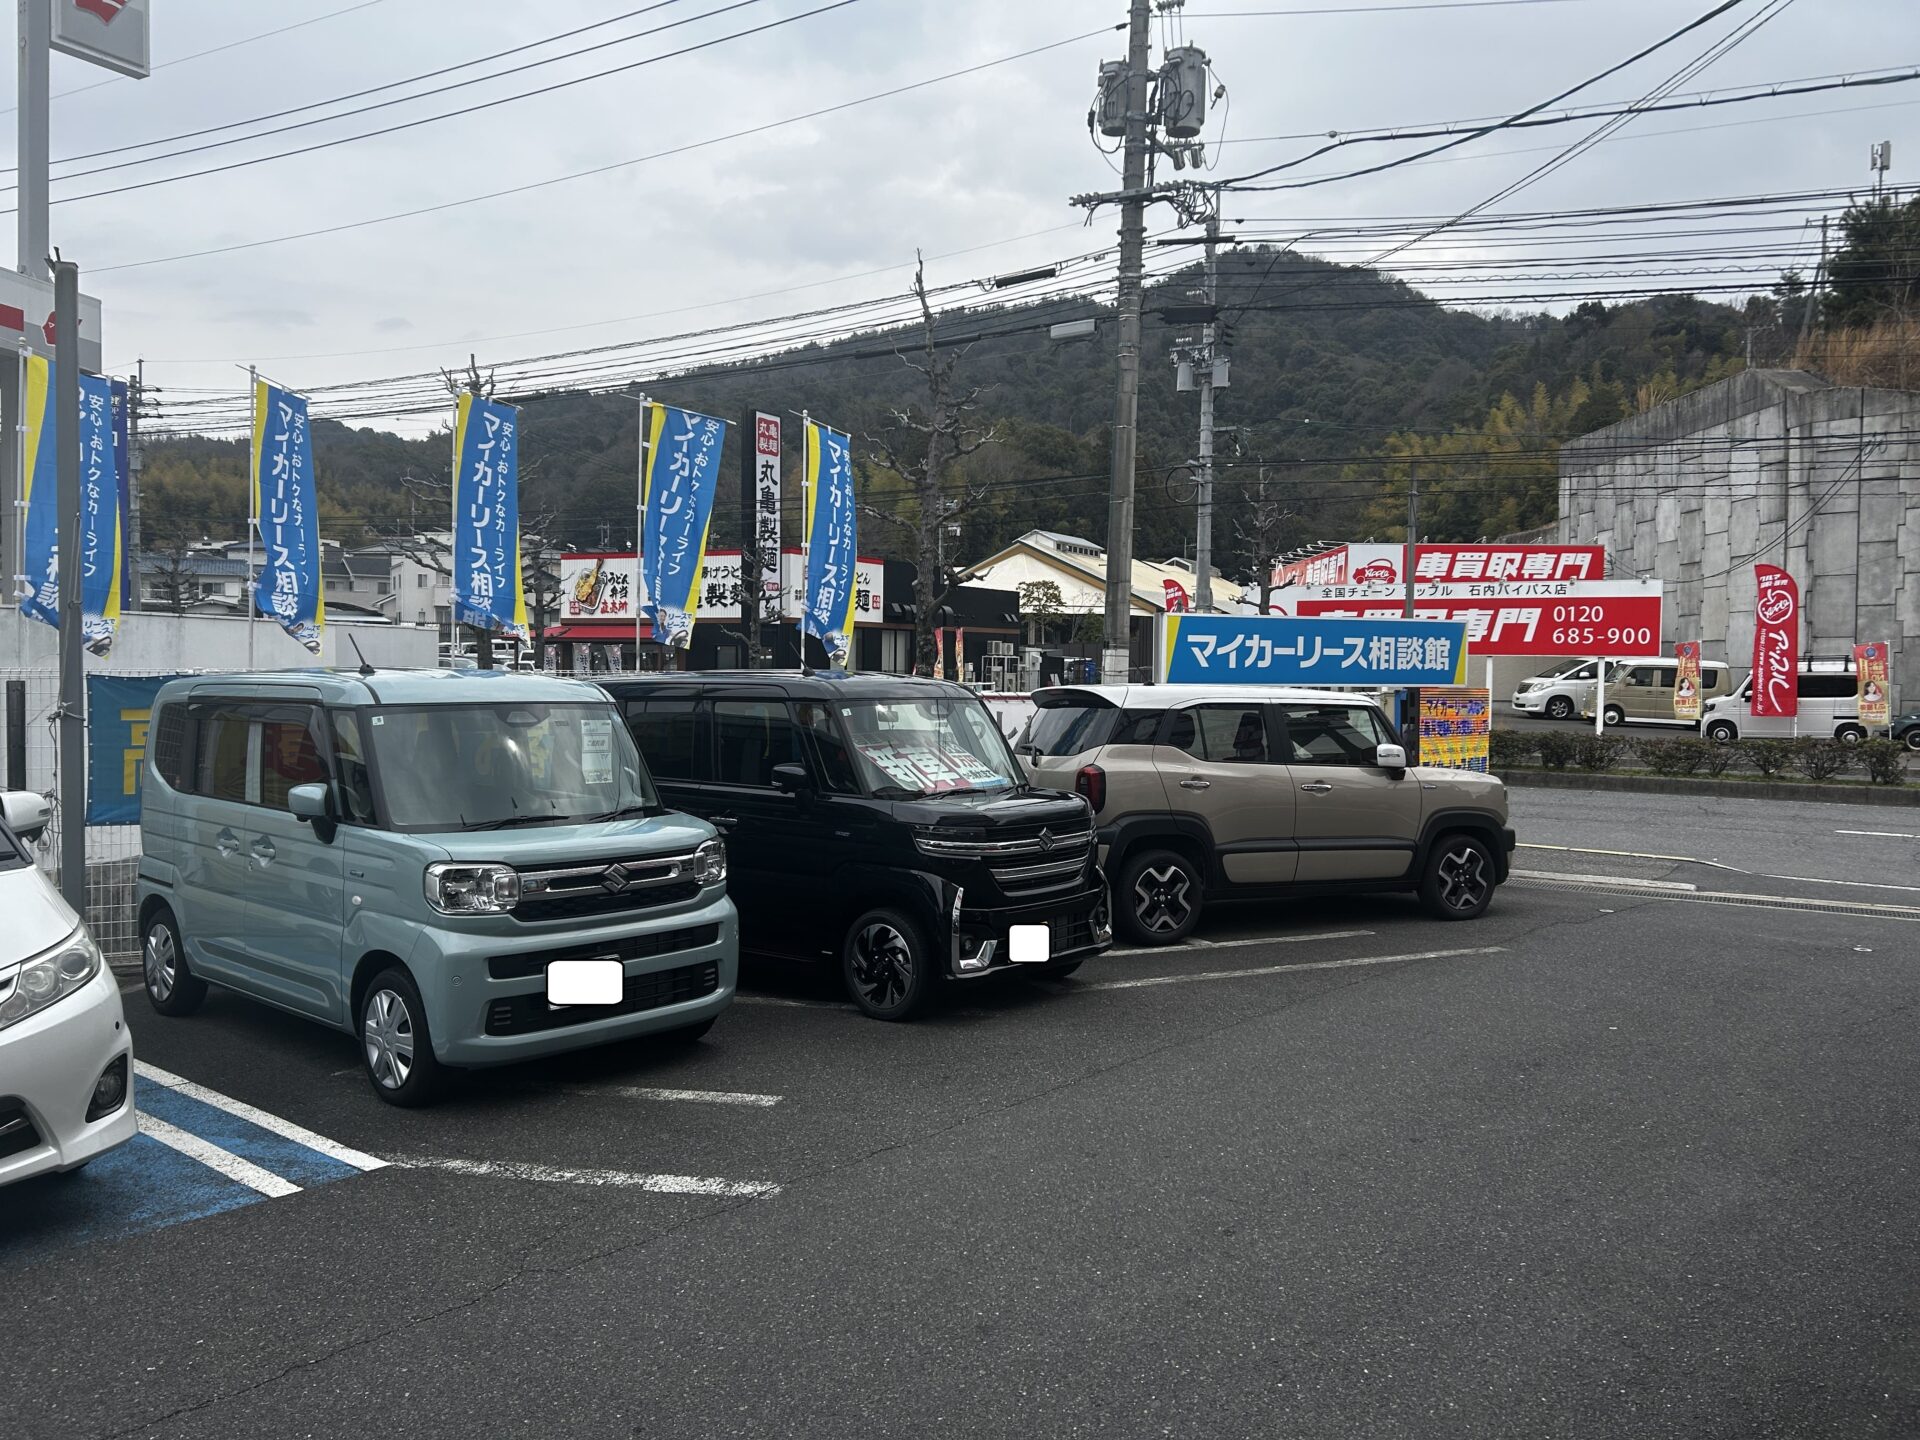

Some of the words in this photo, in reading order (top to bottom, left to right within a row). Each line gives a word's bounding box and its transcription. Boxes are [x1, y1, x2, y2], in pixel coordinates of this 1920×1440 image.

[83, 394, 104, 578] 安心・おトクなカーライフ
[271, 401, 299, 622] マイカーリース相談
[468, 411, 501, 614] マイカーリース相談
[493, 421, 514, 589] 安心・おトクなカーライフ
[758, 459, 779, 574] 丸亀製麺
[813, 439, 843, 626] マイカーリース相談
[607, 571, 630, 585] うどん
[610, 585, 629, 599] 弁当
[1321, 587, 1396, 599] 全国チェーン
[1403, 585, 1453, 598] ップル
[1468, 584, 1568, 597] 石内バイパス店
[1414, 552, 1593, 579] 車買取専門
[1552, 605, 1604, 622] 0120
[1552, 627, 1651, 645] 685-900
[1186, 633, 1451, 672] マイカーリース相談館
[1768, 629, 1790, 713] アップル
